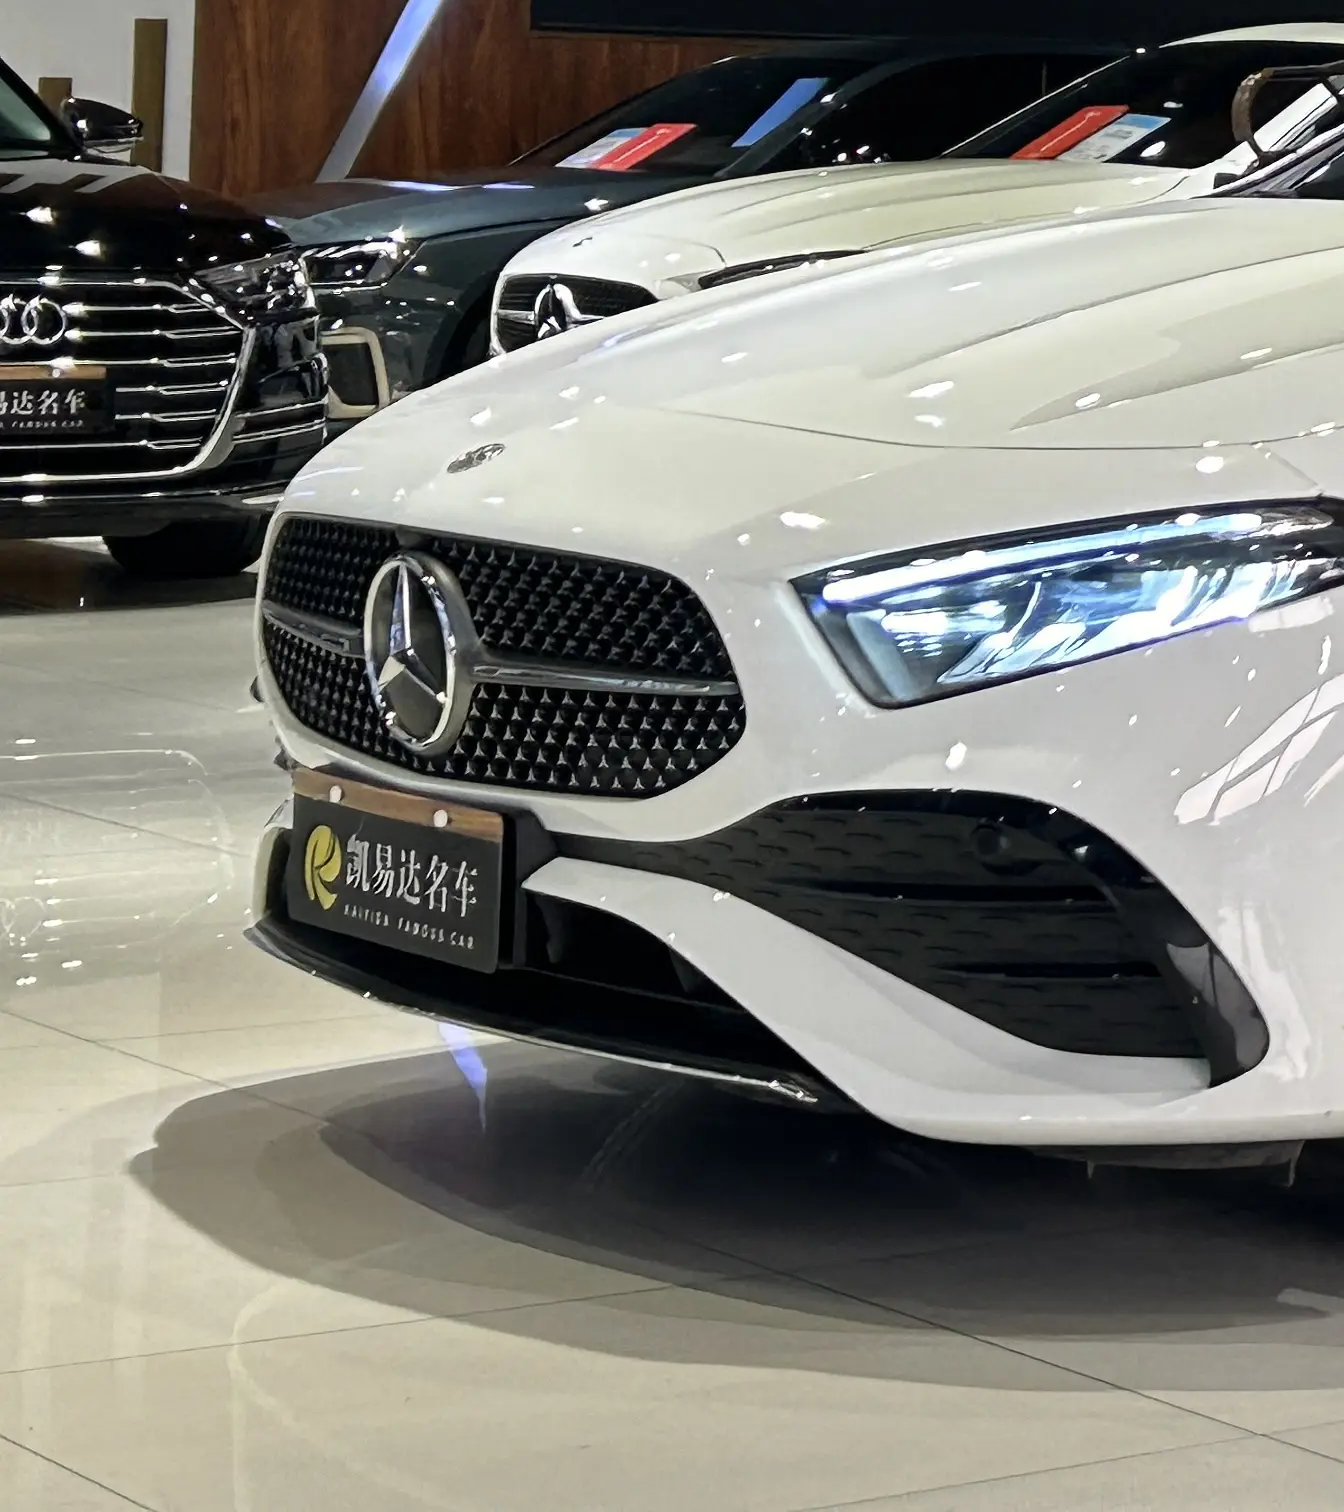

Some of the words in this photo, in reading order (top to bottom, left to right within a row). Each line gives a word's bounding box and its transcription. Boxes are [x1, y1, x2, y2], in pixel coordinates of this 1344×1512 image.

[346, 834, 478, 917] 凯易达名车
